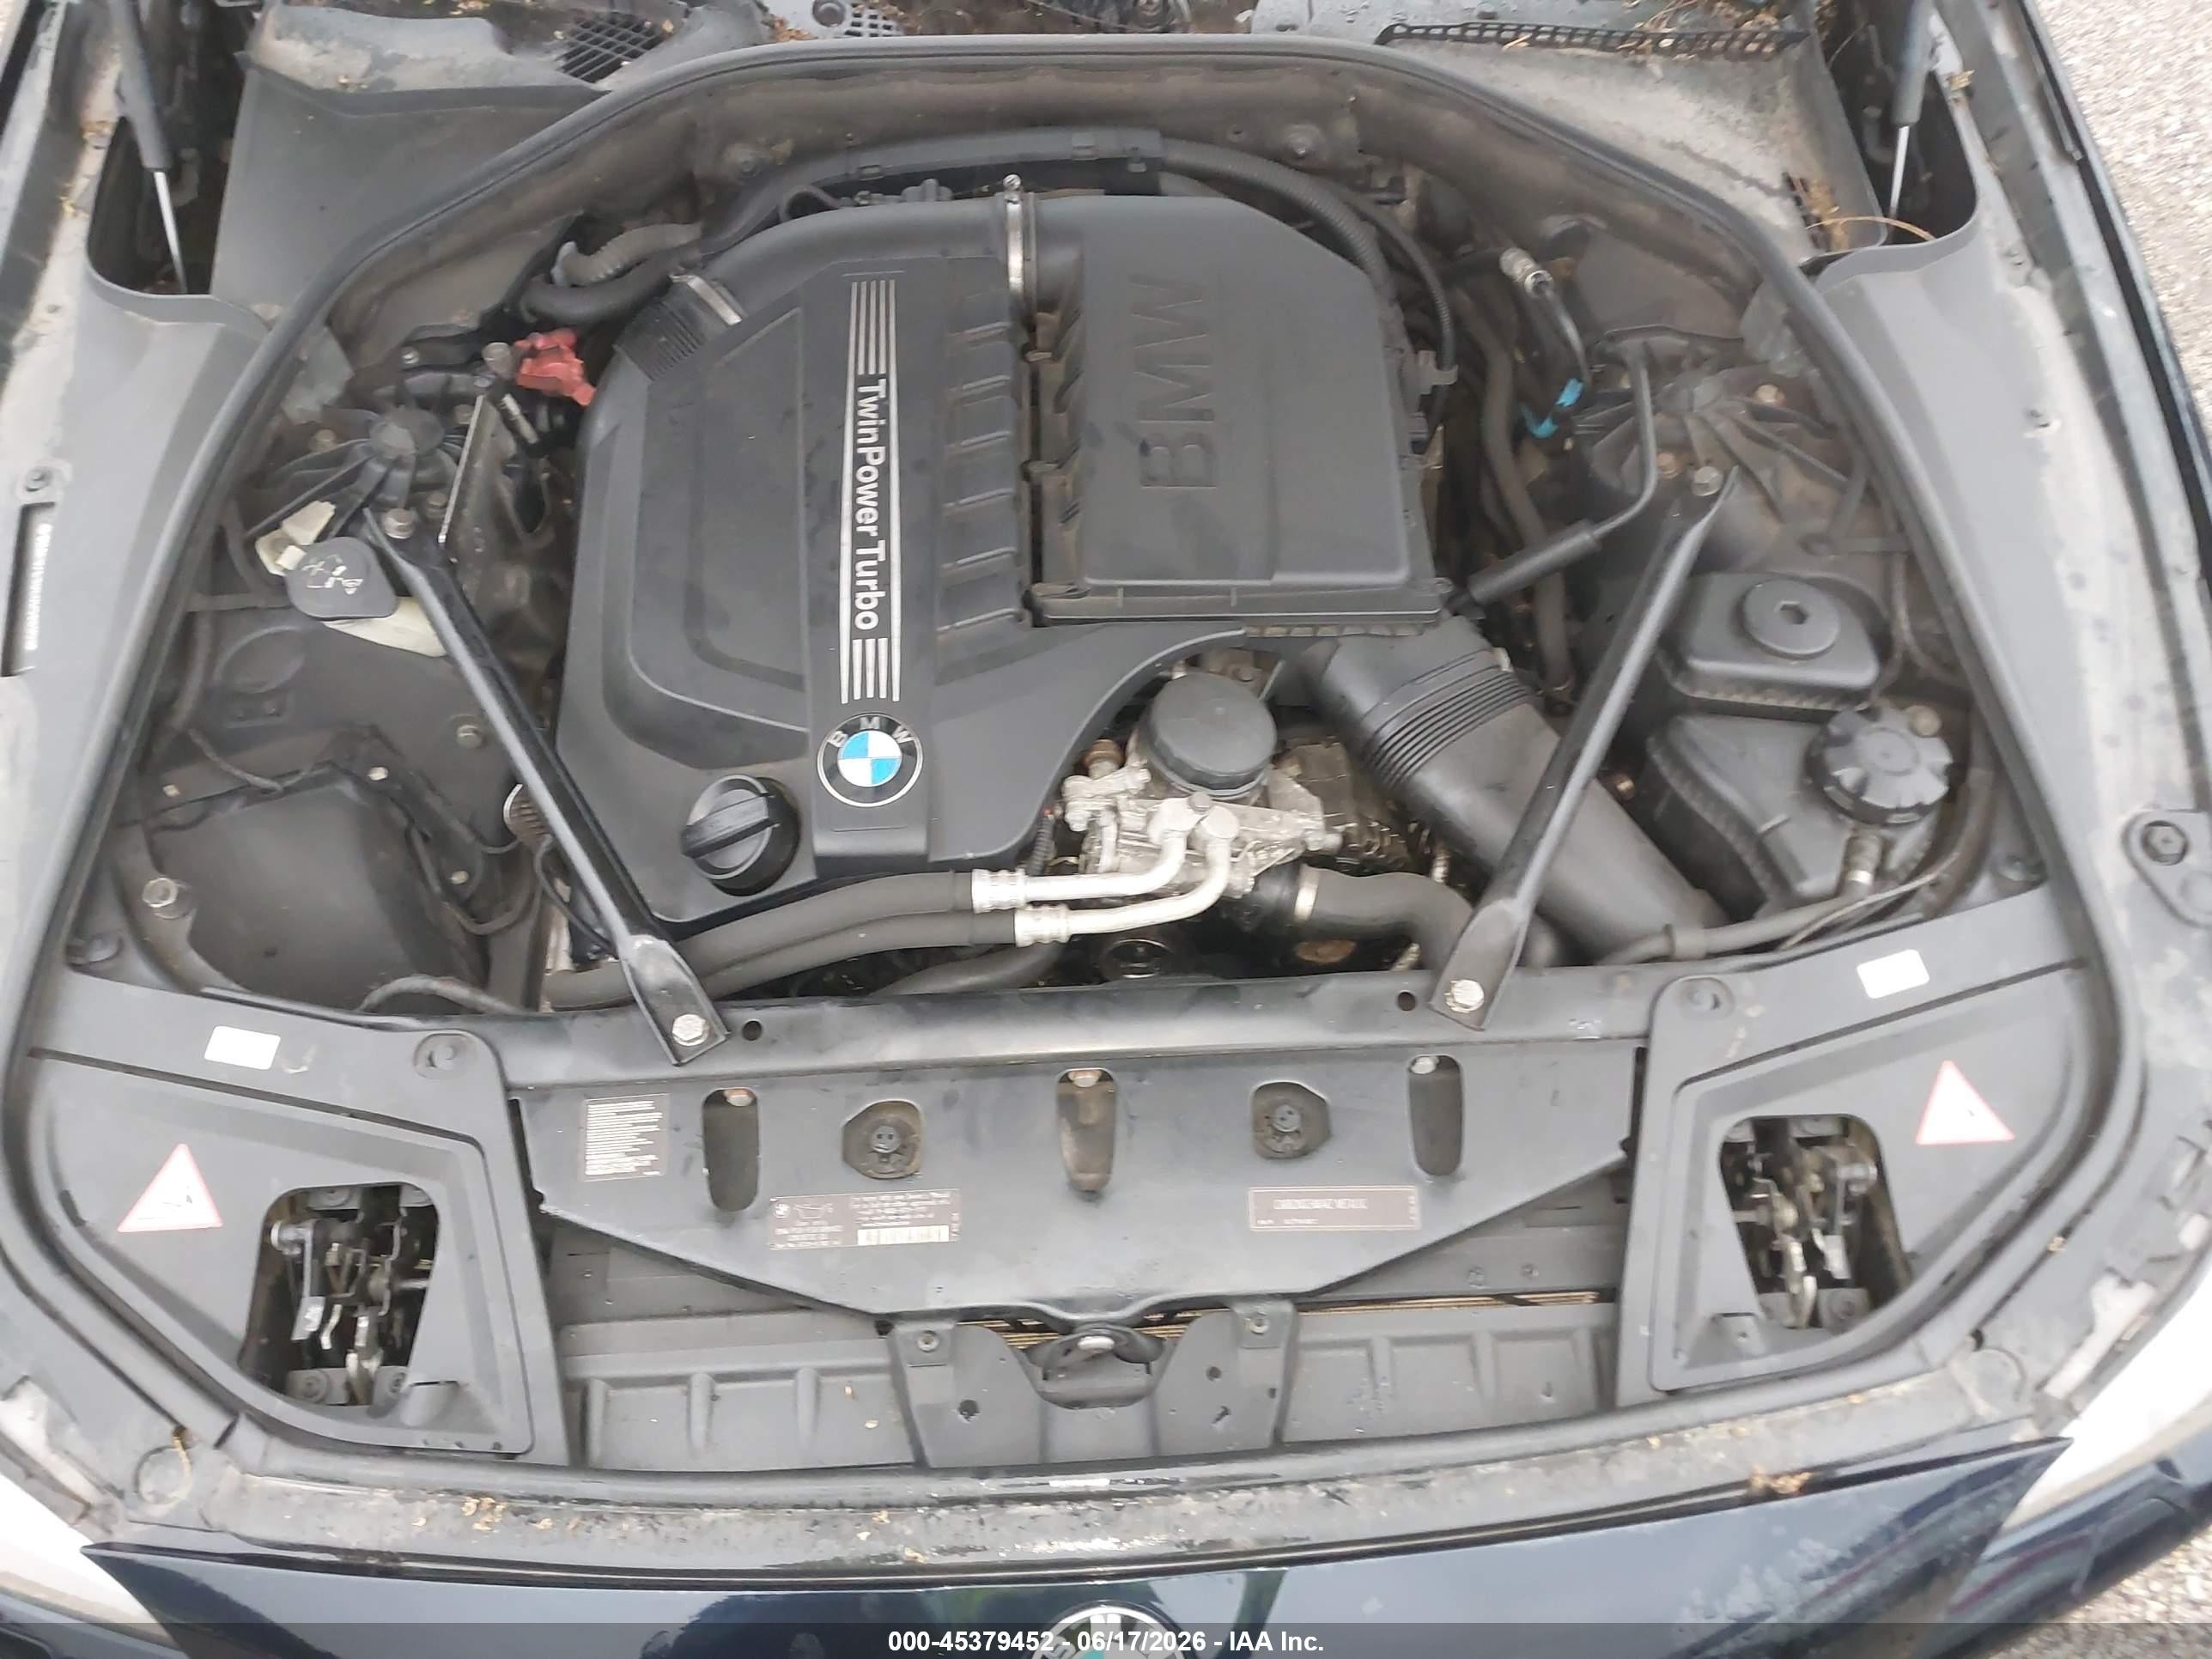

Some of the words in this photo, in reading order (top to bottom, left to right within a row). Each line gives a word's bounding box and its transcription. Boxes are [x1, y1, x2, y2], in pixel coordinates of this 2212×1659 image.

[1128, 275, 1218, 489] BMW
[855, 378, 887, 538] TwinPower
[854, 539, 886, 631] Turbo
[826, 715, 915, 748] BMW
